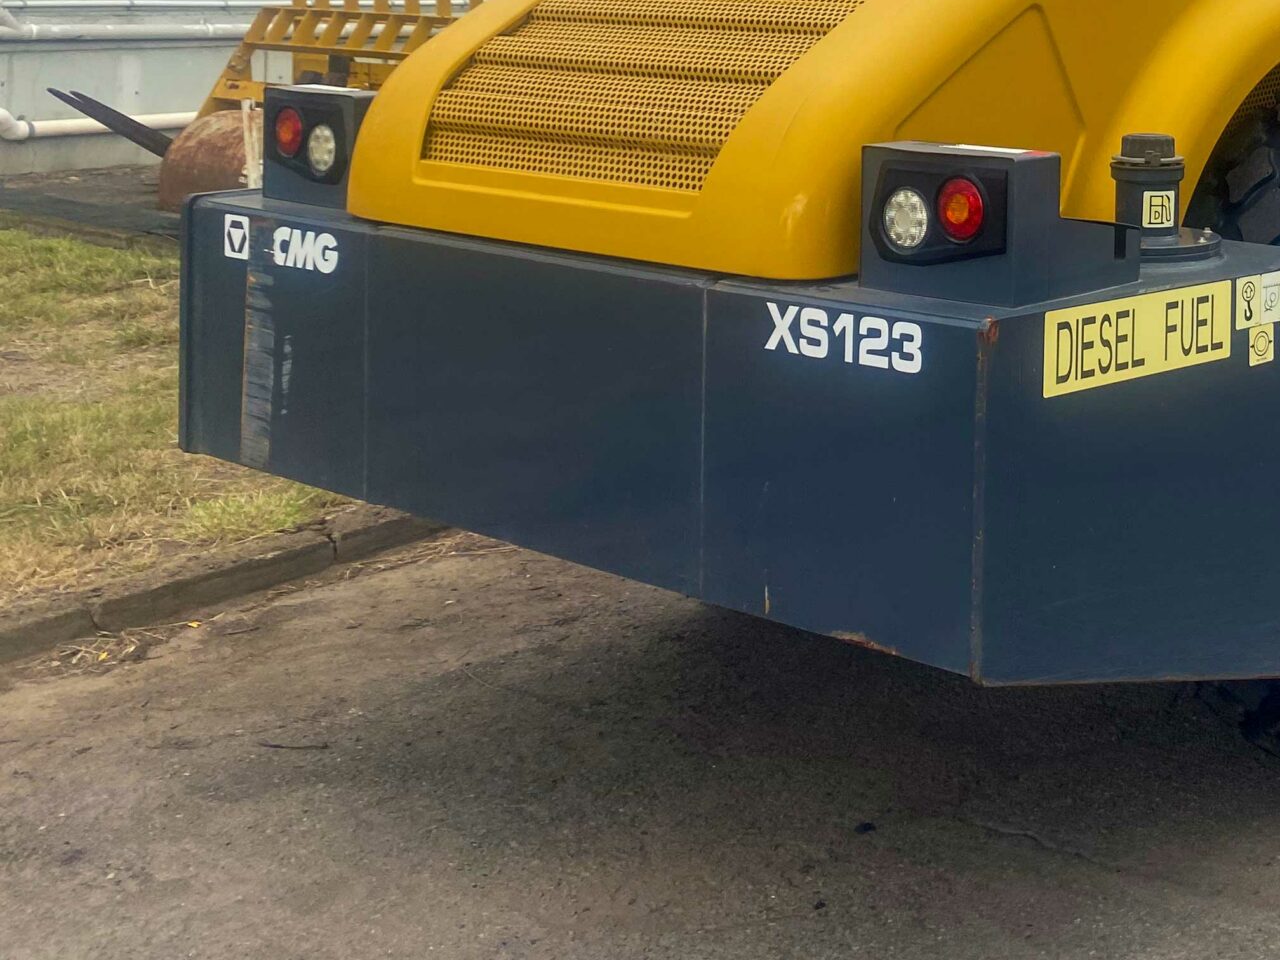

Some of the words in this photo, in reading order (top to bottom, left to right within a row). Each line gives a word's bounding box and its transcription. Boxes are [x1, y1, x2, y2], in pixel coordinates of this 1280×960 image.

[765, 301, 922, 374] XS123
[1055, 309, 1145, 384] DIESEL
[1164, 294, 1223, 361] FUEL
